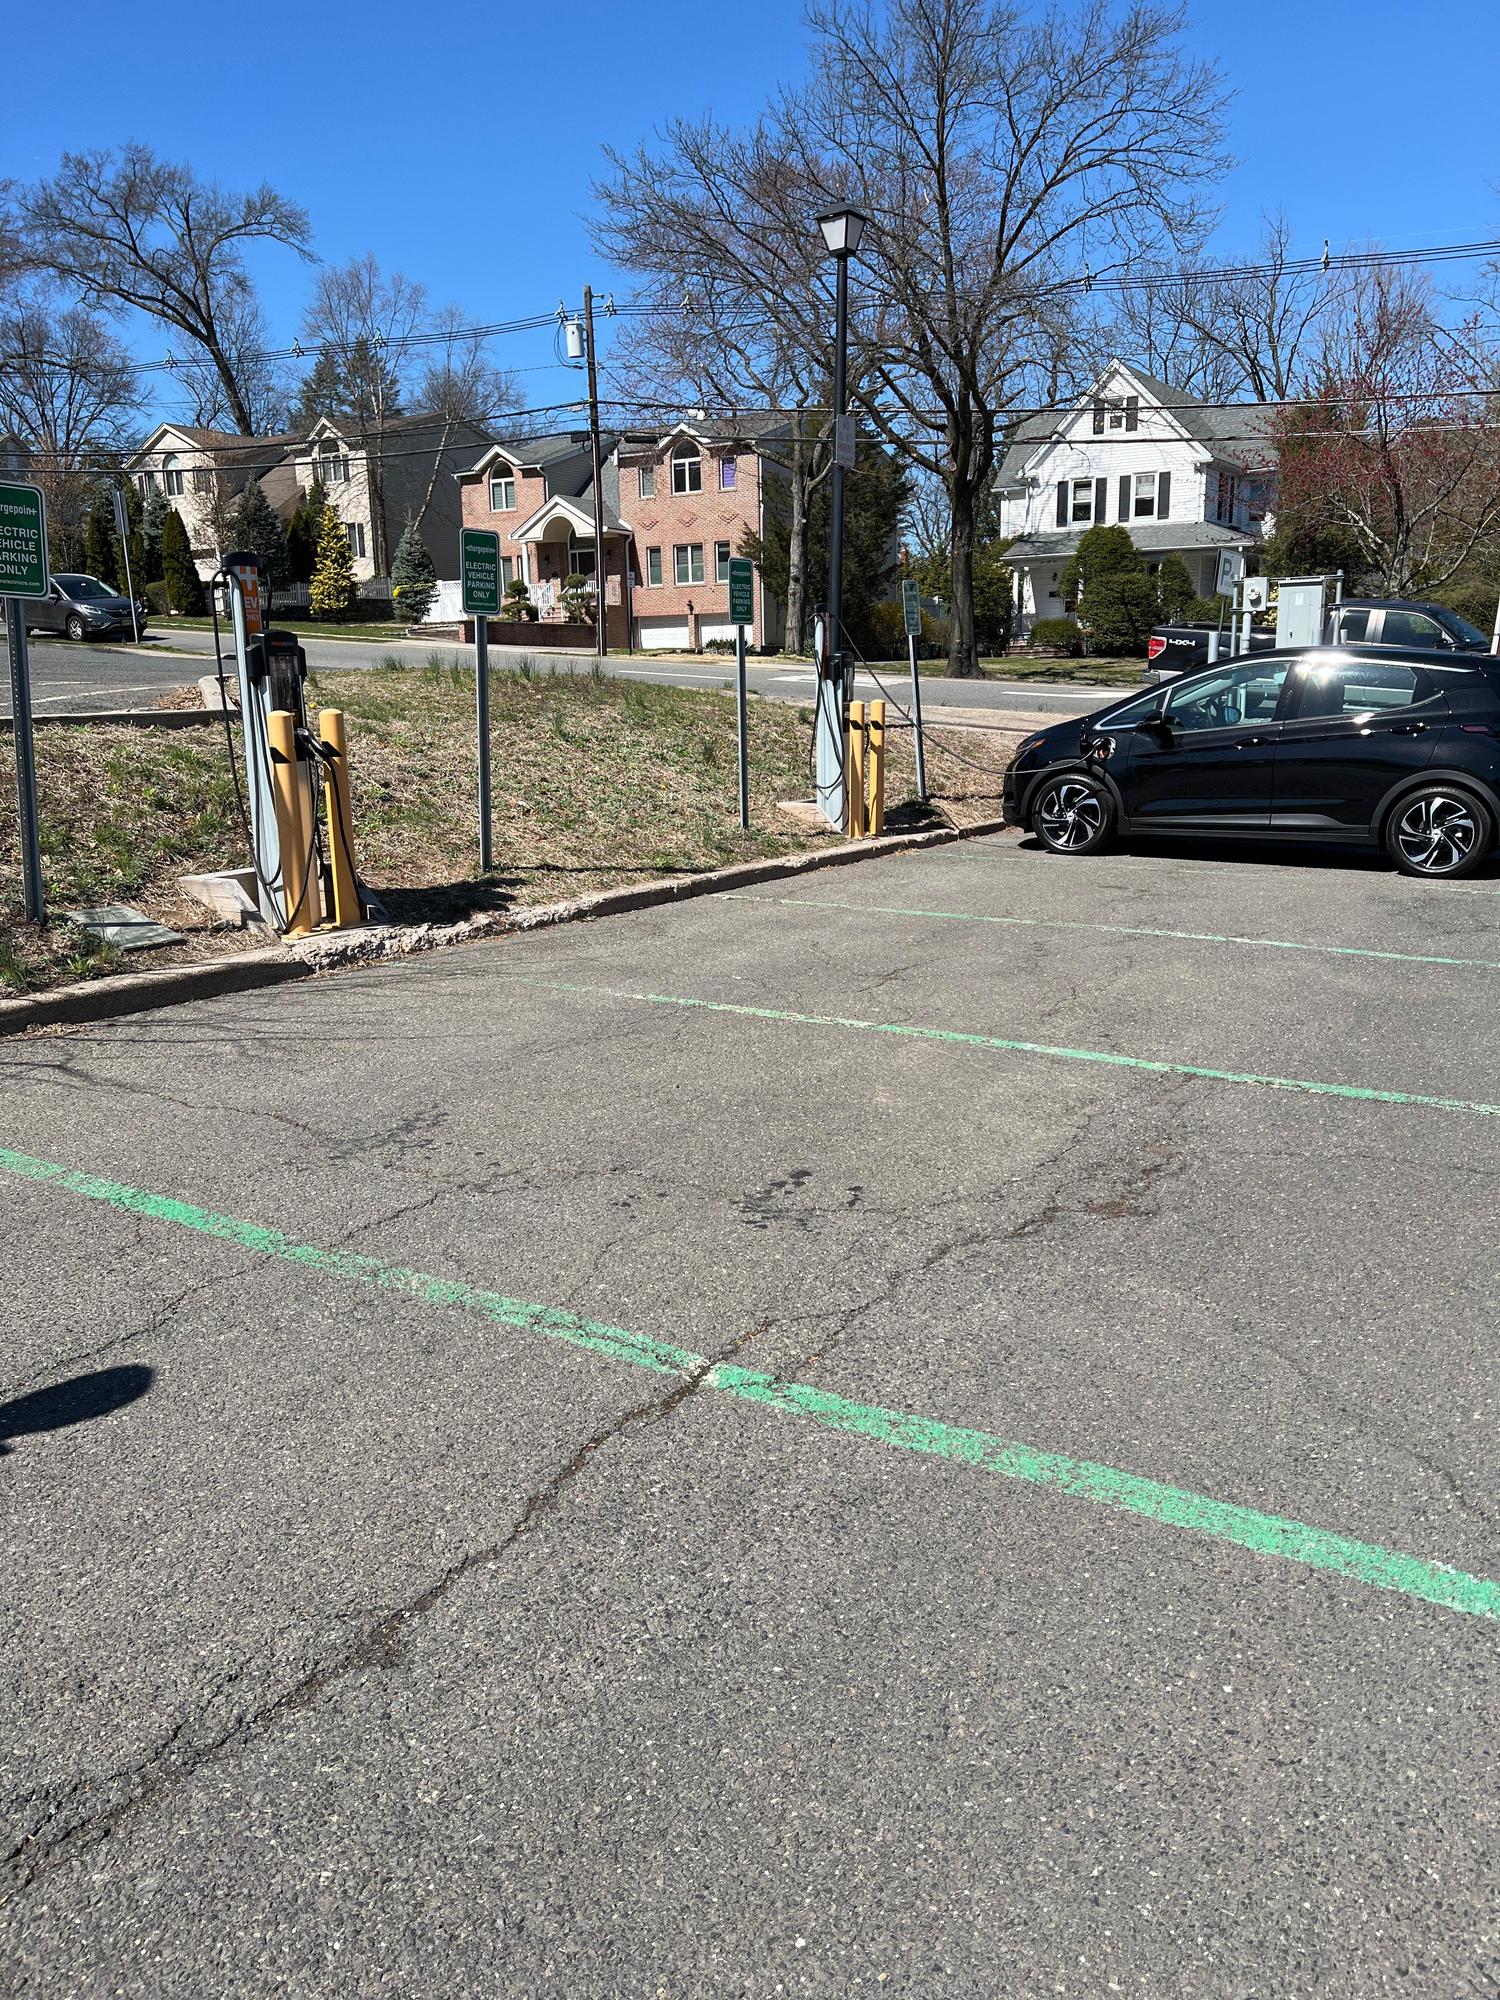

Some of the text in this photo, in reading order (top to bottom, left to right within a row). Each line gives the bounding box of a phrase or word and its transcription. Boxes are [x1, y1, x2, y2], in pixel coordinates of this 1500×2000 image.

[0, 563, 28, 576] ONLY
[465, 561, 497, 571] ELECTRIC
[467, 571, 495, 581] VEHICLE
[467, 580, 496, 590] PARKING
[472, 590, 490, 599] ONLY
[244, 596, 257, 609] EV
